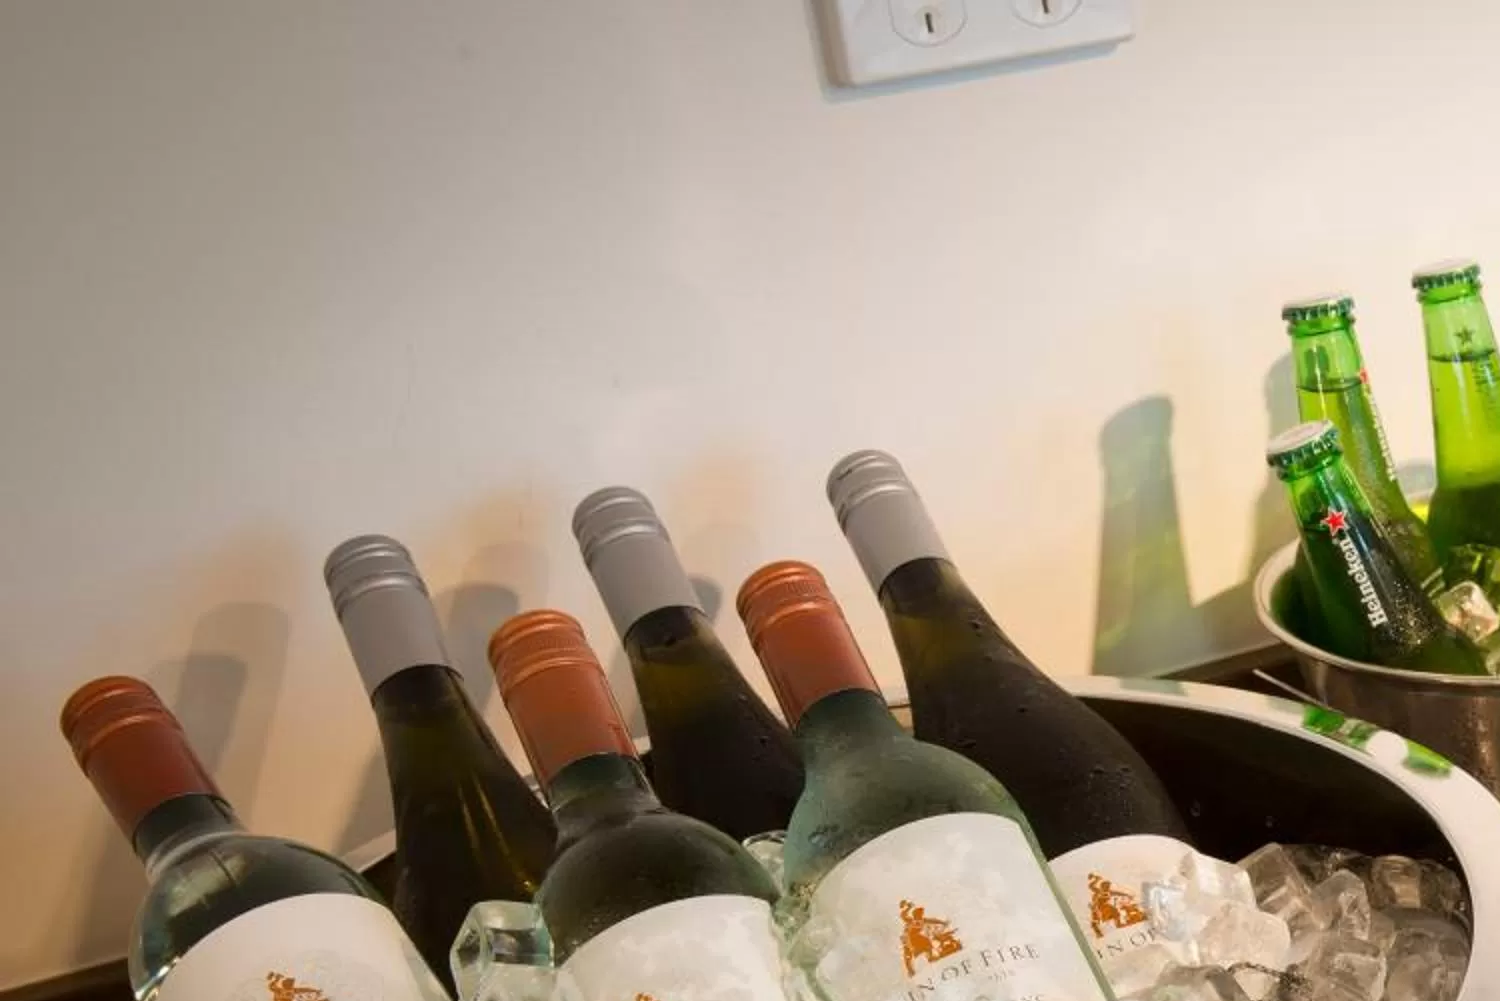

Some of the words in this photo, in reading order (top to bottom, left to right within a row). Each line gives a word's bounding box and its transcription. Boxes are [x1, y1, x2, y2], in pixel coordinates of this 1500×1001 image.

[1339, 536, 1389, 629] Heineken
[941, 959, 972, 982] OF
[980, 944, 1040, 967] FIRE
